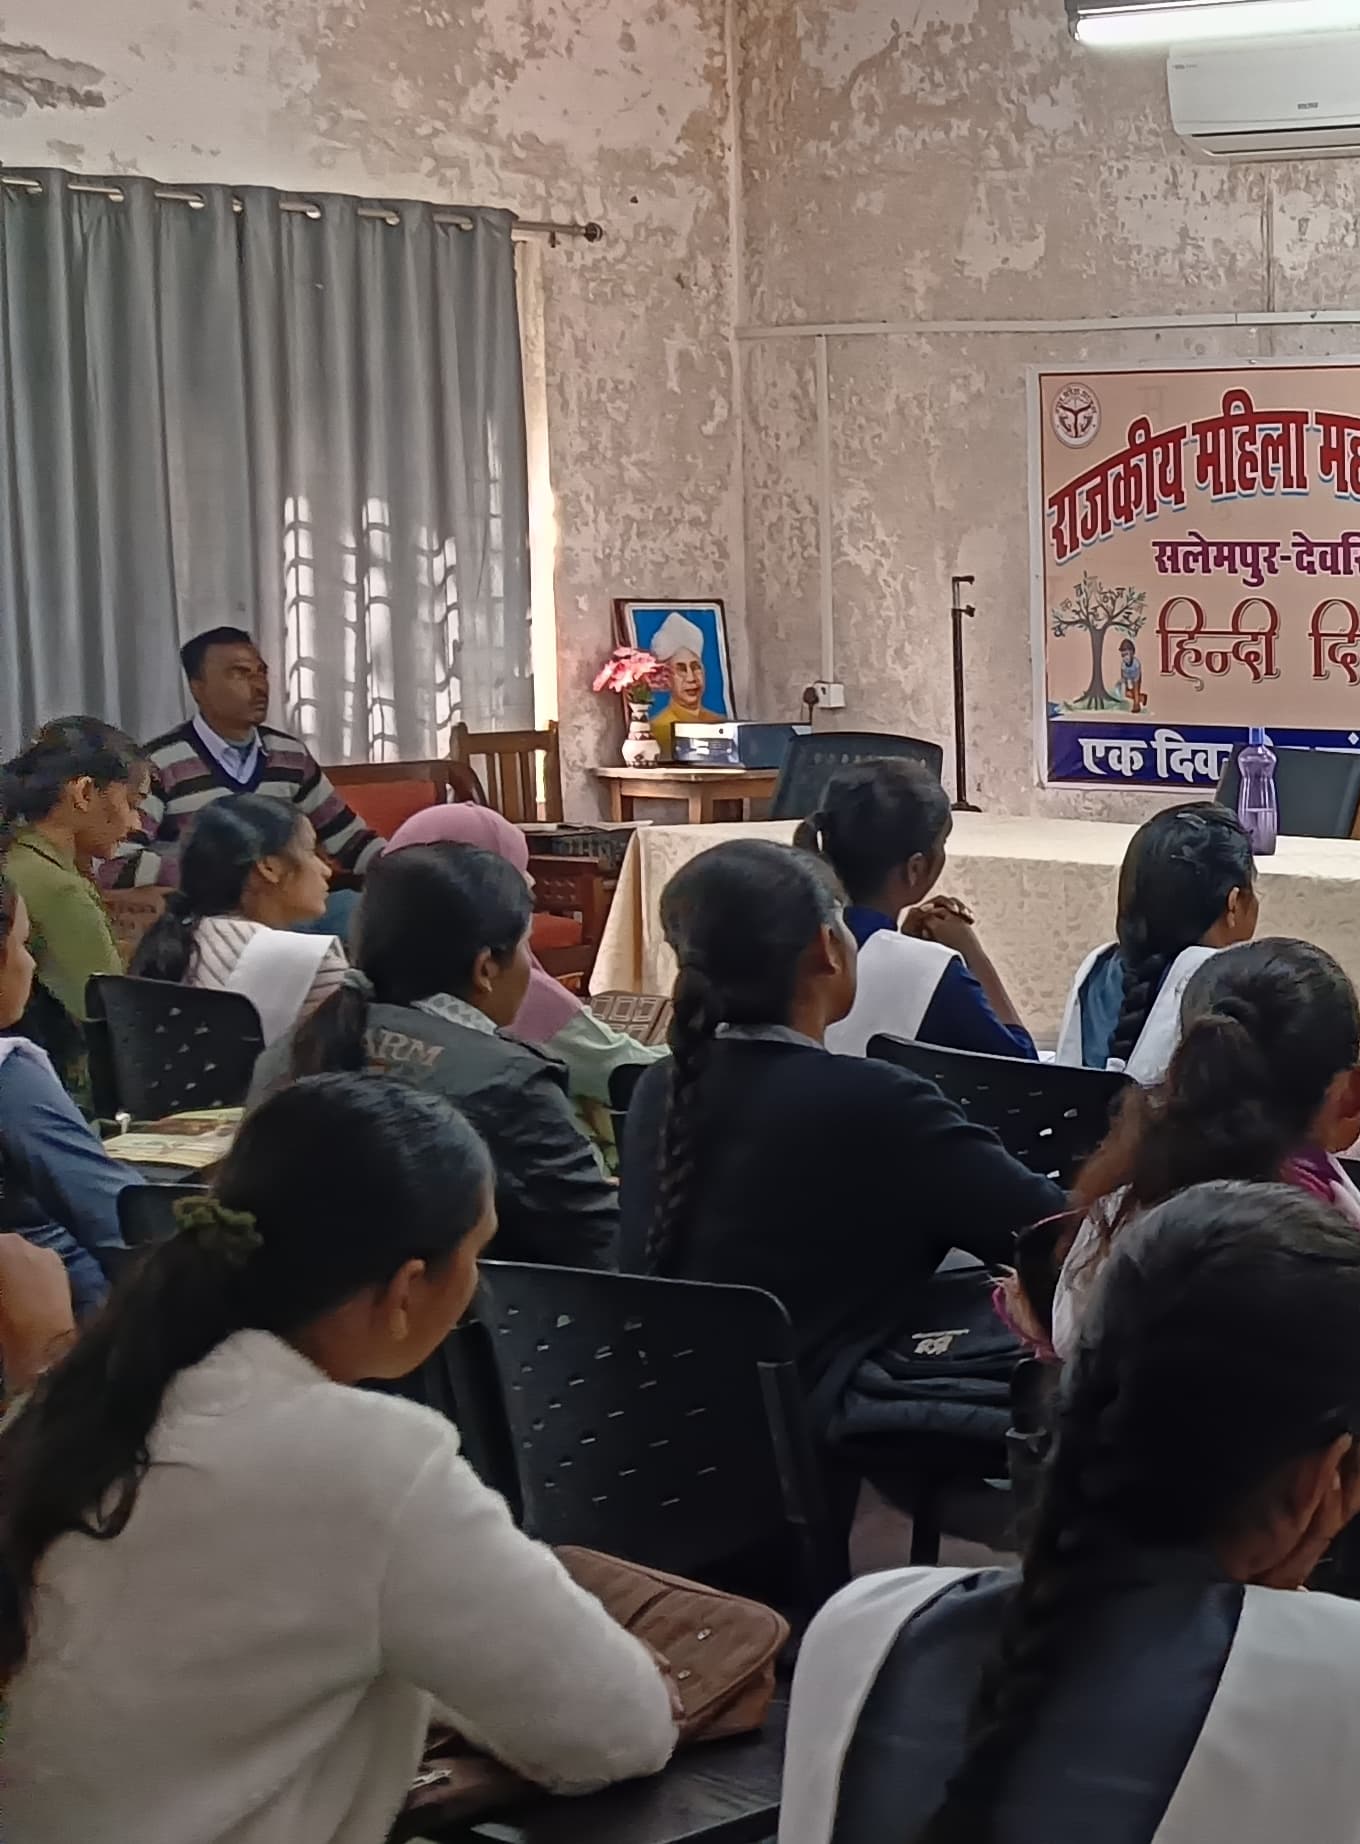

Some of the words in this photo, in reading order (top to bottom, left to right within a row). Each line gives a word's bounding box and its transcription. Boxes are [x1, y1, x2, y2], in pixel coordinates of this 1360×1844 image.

[1048, 416, 1188, 560] राजकीय
[1192, 389, 1308, 497] महिला
[1156, 597, 1281, 691] हिन्दी
[1078, 737, 1148, 777] एक
